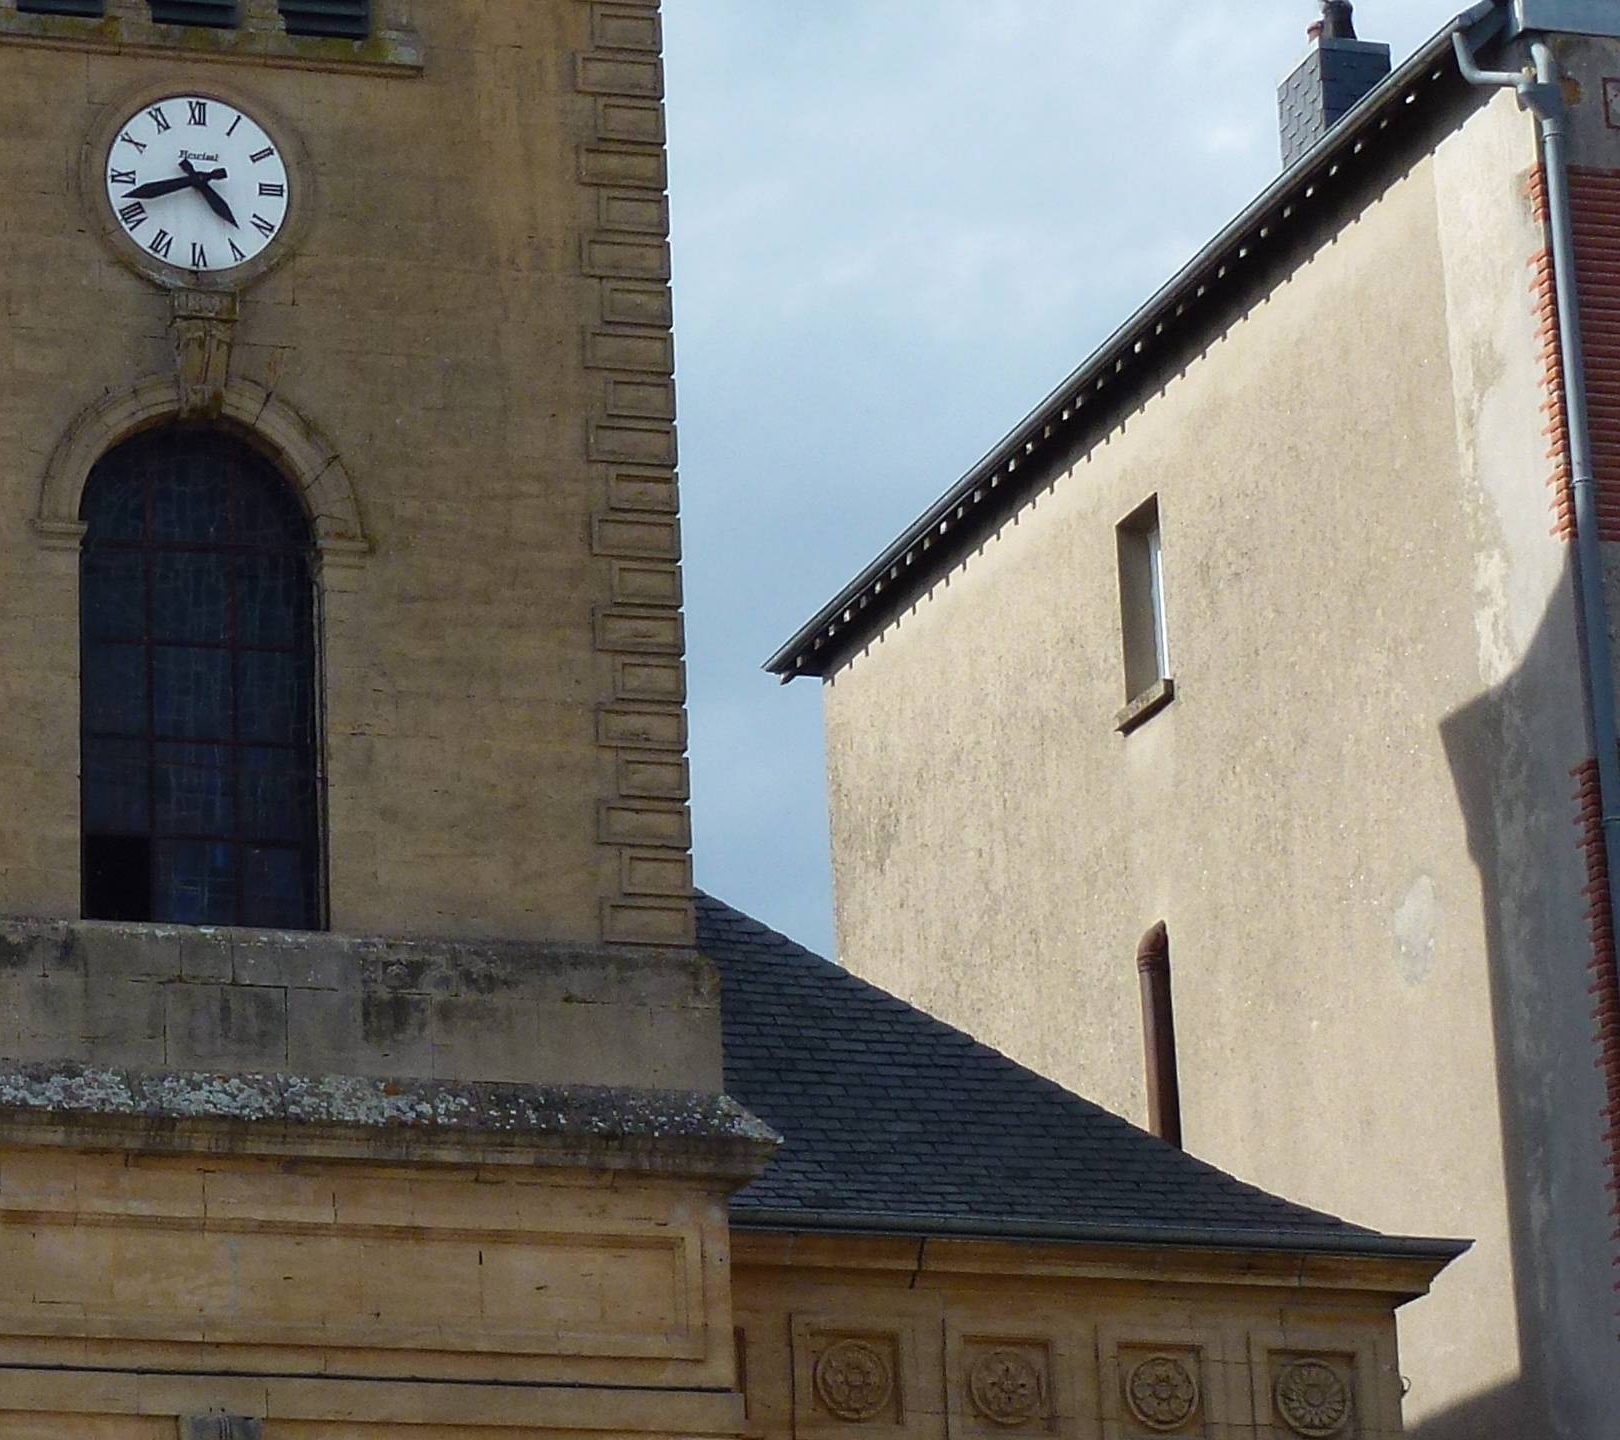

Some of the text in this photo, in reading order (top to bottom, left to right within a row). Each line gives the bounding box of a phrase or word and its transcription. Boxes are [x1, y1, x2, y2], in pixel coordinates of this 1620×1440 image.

[147, 106, 171, 134] XI
[188, 101, 207, 126] XII
[226, 115, 241, 136] I
[121, 132, 146, 153] X
[250, 147, 274, 163] II
[111, 168, 136, 185] IX
[259, 183, 284, 197] III
[119, 201, 148, 232] VIII
[251, 214, 275, 238] IV
[148, 229, 173, 260] VII
[191, 243, 208, 268] VI
[228, 238, 246, 261] V
